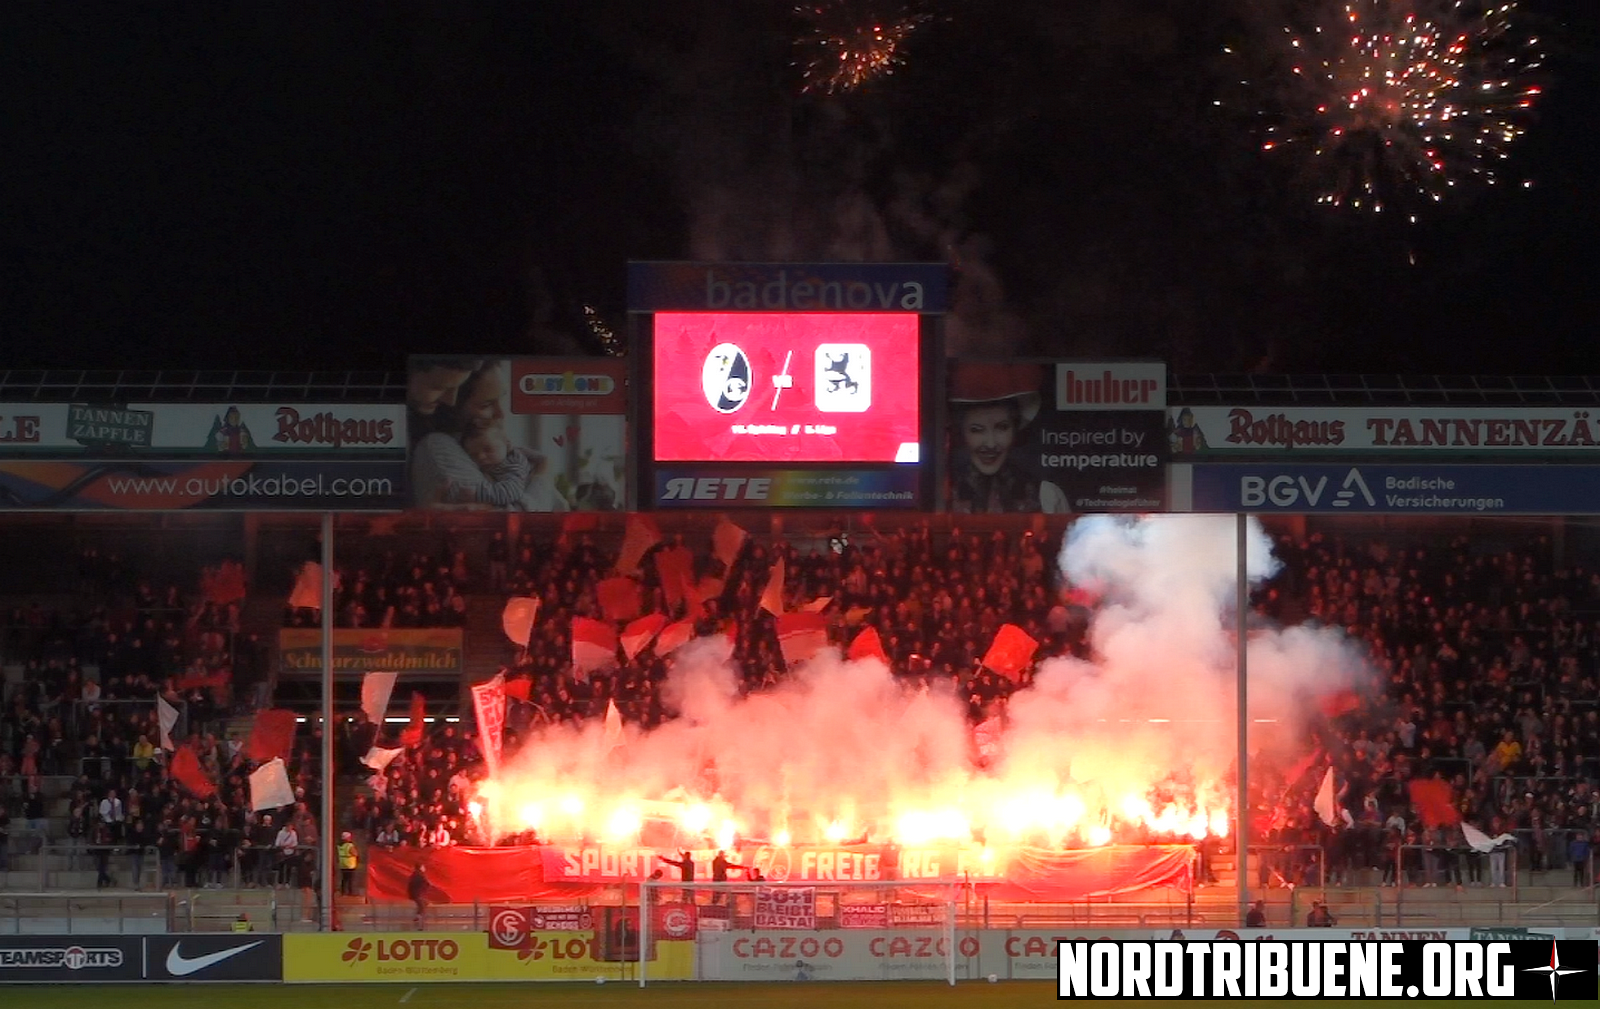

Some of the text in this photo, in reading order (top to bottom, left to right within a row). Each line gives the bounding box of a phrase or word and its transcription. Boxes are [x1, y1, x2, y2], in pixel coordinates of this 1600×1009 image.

[706, 268, 922, 310] badenova
[1066, 370, 1157, 404] huber
[72, 408, 149, 426] TANNEN
[272, 407, 394, 448] Rothaus
[73, 424, 146, 442] ZÄPFLE
[1042, 429, 1145, 448] Inspired by
[1225, 408, 1345, 450] Rothaus
[1366, 411, 1600, 446] TANNENZÄ
[1041, 453, 1158, 471] temperature
[108, 473, 393, 497] www.autokabel.com
[1241, 475, 1328, 507] BGV
[1386, 476, 1456, 490] Badische
[1386, 494, 1505, 510] Versicherungen
[801, 851, 940, 880] FREIBRG
[377, 940, 458, 960] LOTTO
[732, 937, 844, 957] CAZOO
